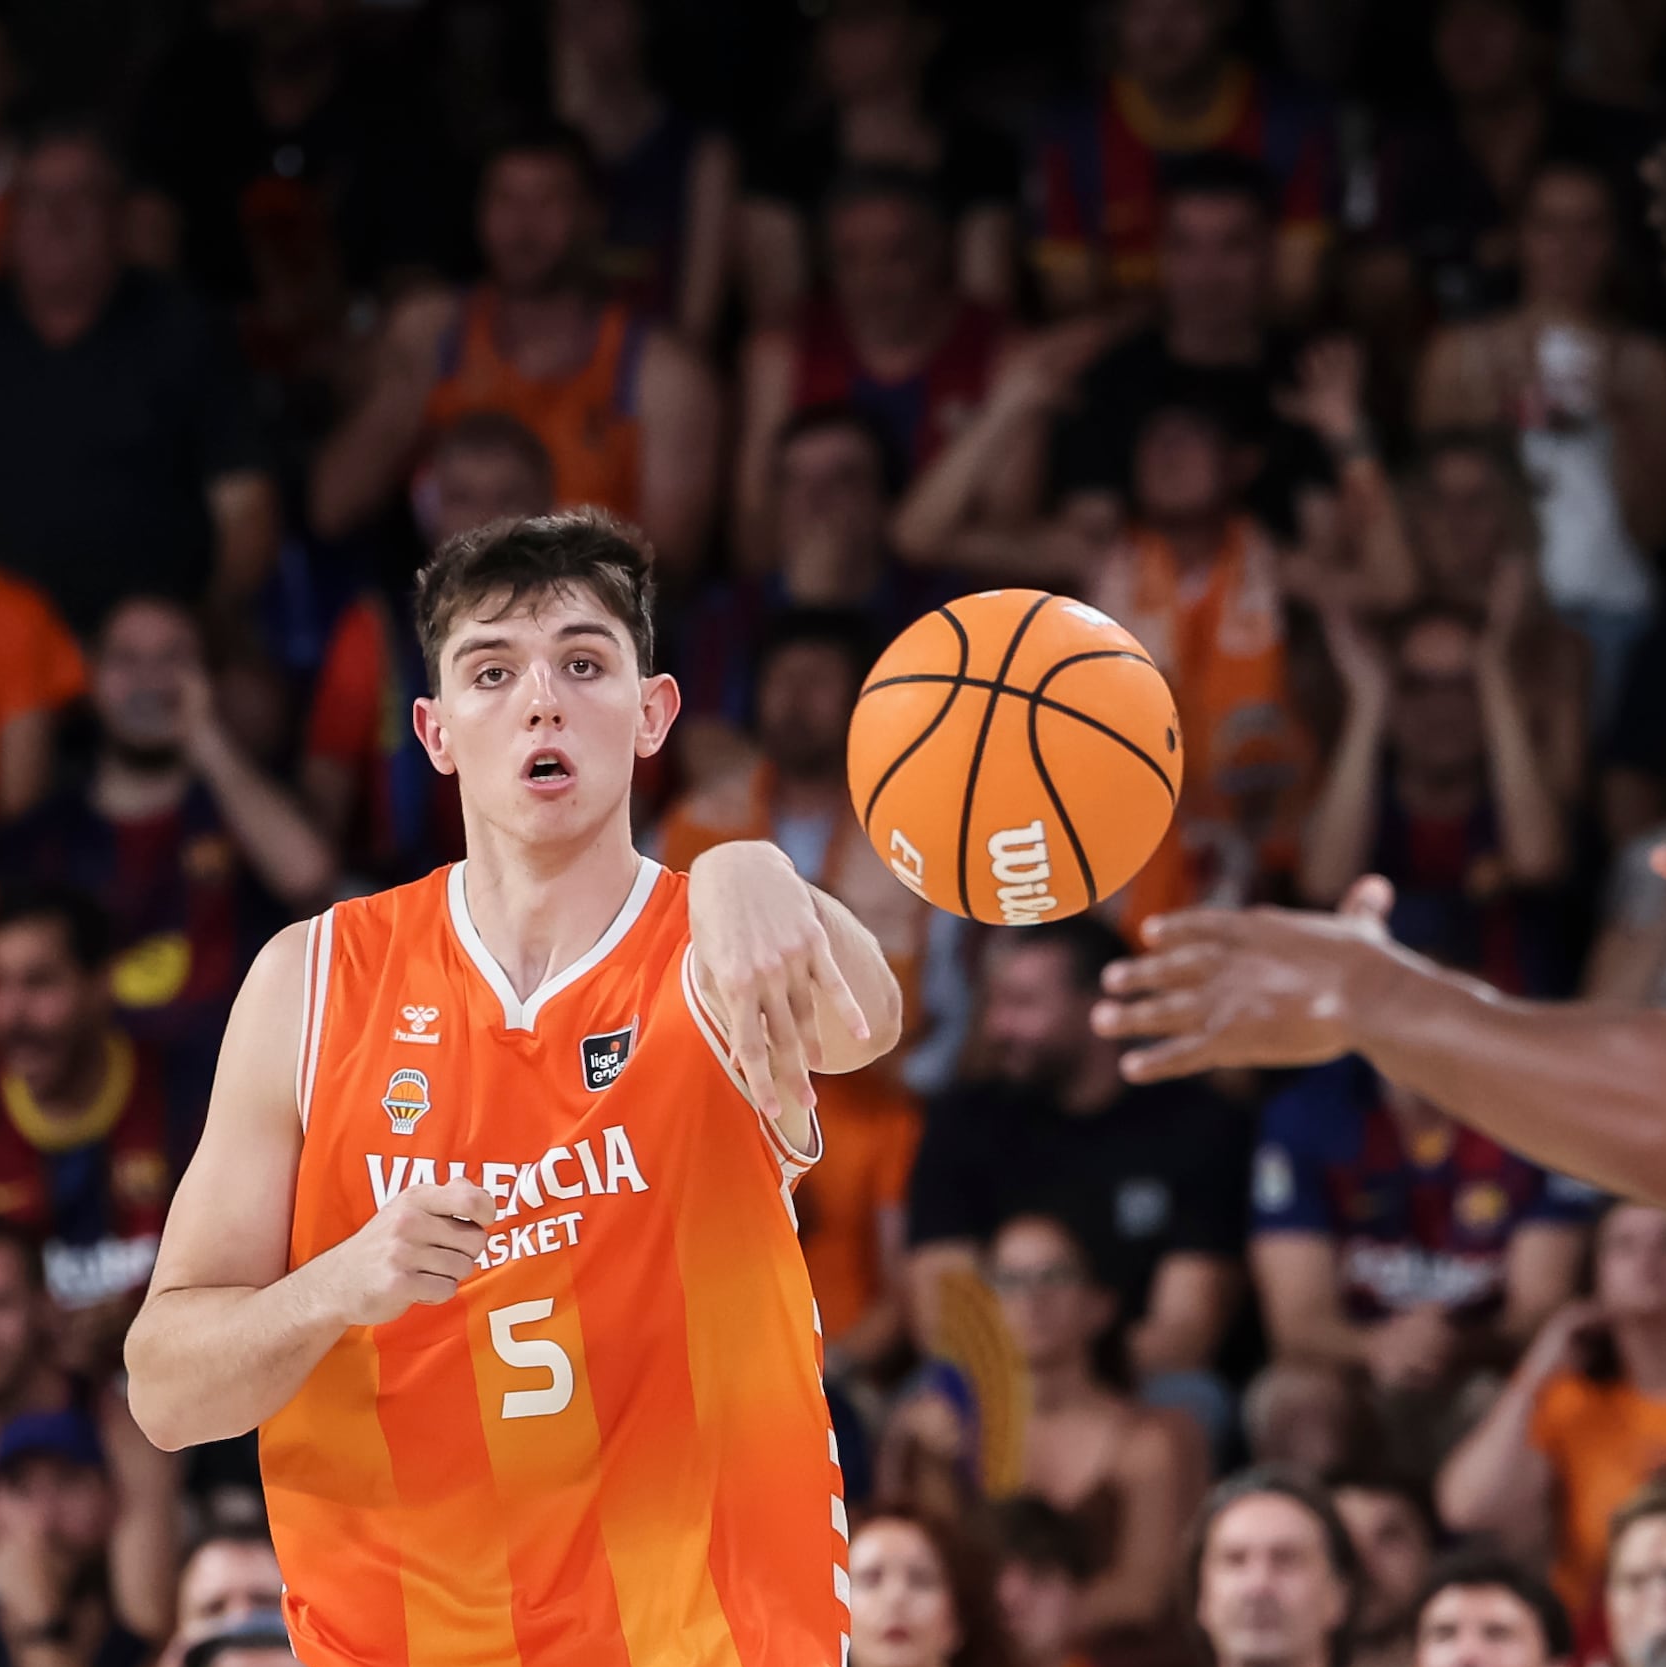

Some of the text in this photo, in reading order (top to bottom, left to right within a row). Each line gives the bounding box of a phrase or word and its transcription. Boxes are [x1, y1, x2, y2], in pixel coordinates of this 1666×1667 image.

[590, 1052, 618, 1069] liga
[593, 1062, 626, 1082] end
[365, 1125, 649, 1222] VAENCIA
[474, 1211, 583, 1269] SKET
[488, 1297, 574, 1419] 5
